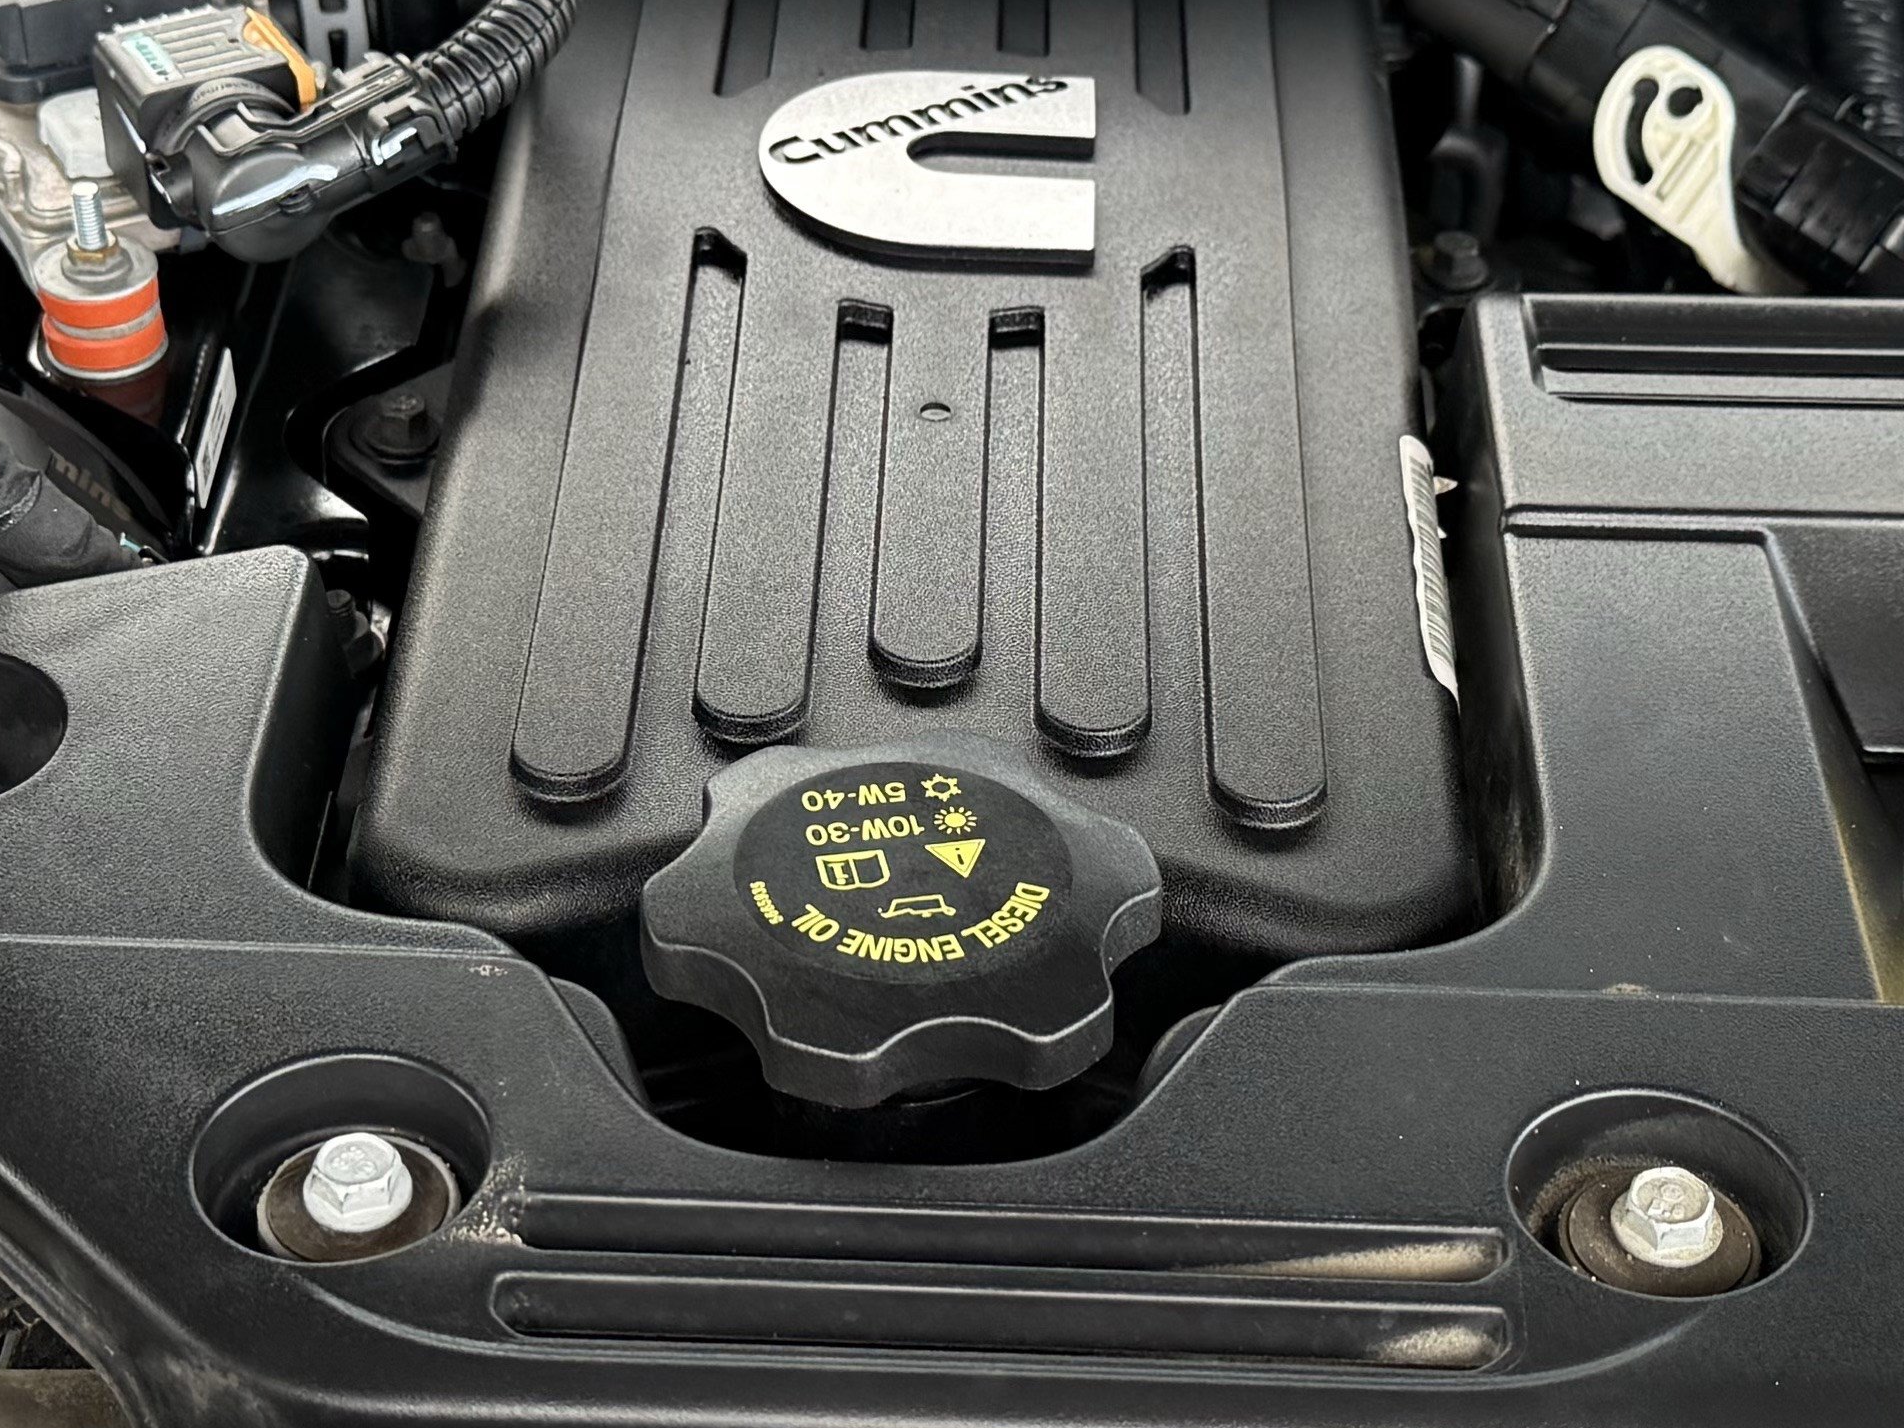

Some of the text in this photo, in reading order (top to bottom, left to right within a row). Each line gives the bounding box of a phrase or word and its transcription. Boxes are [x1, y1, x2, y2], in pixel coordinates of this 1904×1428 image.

[767, 74, 1069, 167] Cummins
[801, 781, 906, 812] 5W-40
[806, 815, 925, 846] 10W-30
[791, 881, 1050, 963] DIESEL ENGINE OIL
